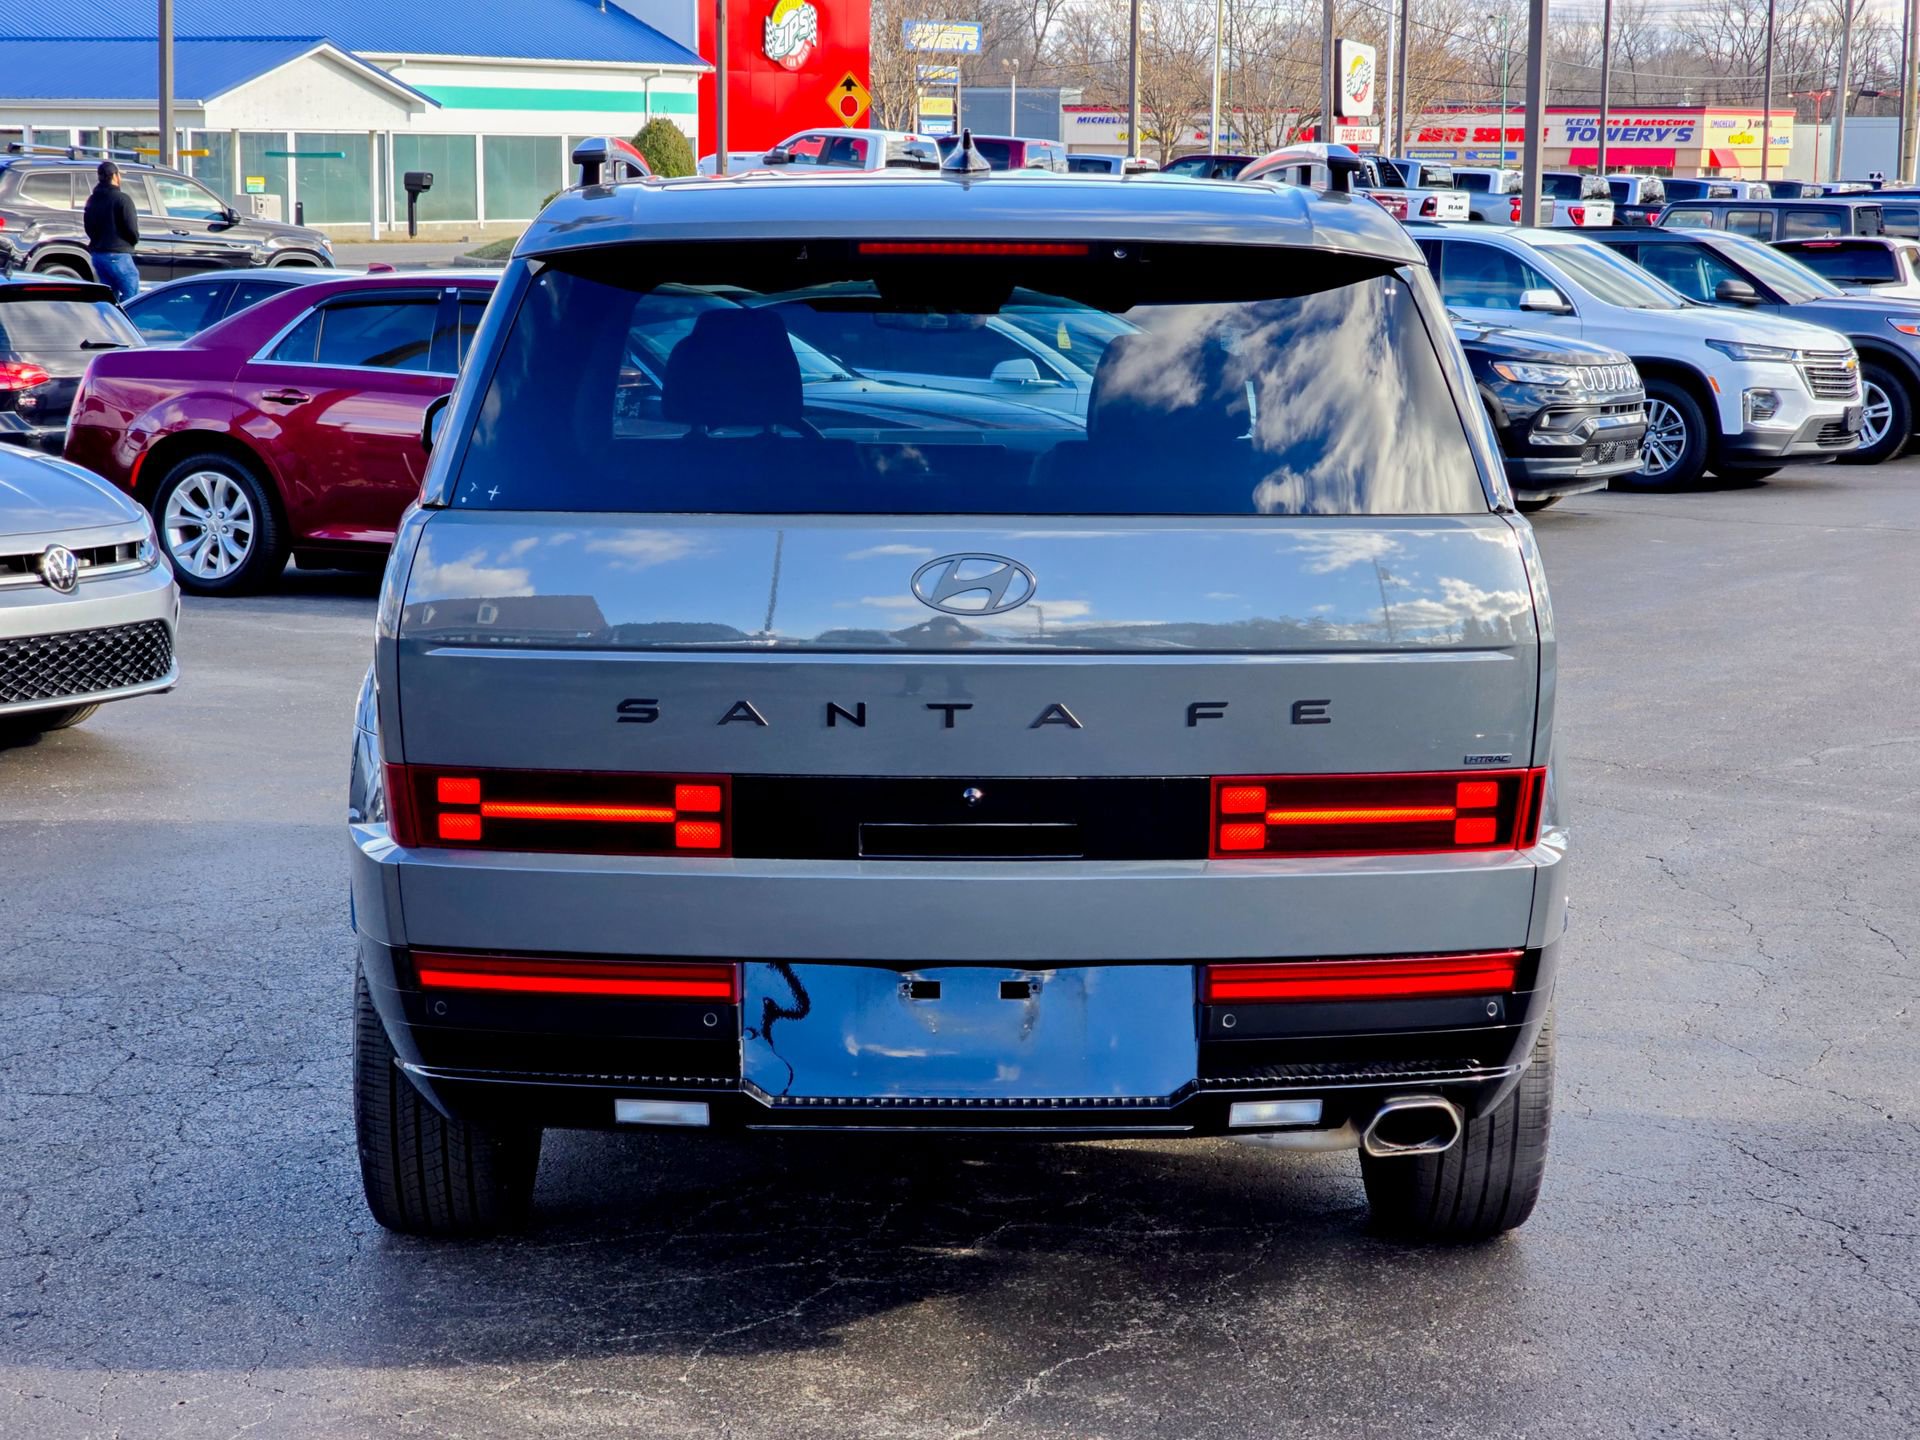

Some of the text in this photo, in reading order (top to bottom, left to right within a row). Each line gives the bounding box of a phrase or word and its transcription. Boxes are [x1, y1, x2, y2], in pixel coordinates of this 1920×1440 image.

[774, 8, 810, 57] ZIPS
[1622, 118, 1631, 126] &
[1633, 118, 1696, 126] AutoCare
[1341, 129, 1373, 141] FREE VACS
[1409, 151, 1455, 160] Suspension
[615, 697, 1333, 730] SANTA FE
[1467, 755, 1511, 763] HTRAC
